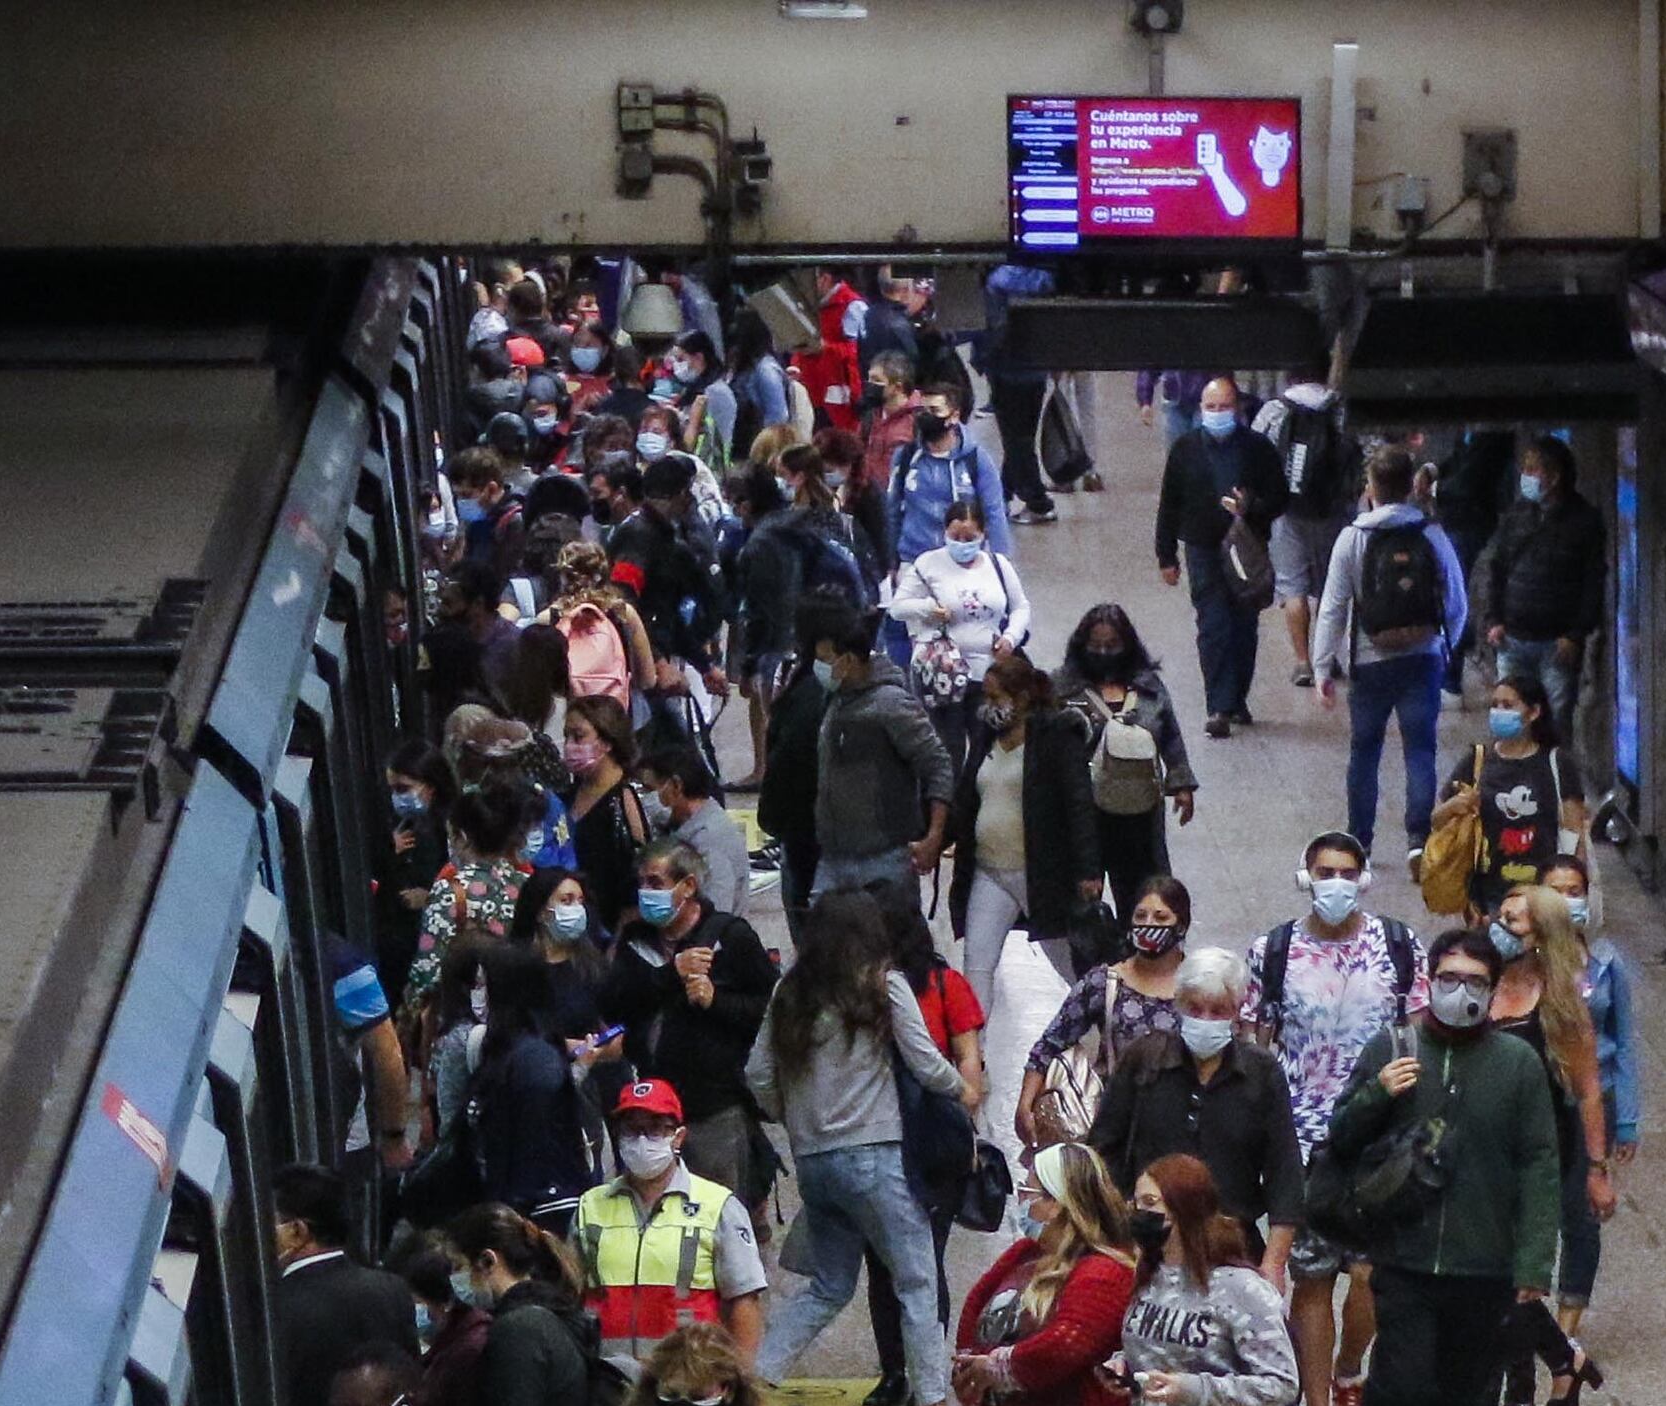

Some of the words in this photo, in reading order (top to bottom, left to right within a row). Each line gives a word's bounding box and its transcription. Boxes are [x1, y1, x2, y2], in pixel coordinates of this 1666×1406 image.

[1090, 109, 1159, 122] Cuéntanos
[1161, 110, 1199, 123] sobre
[1090, 124, 1105, 136] tu
[1107, 123, 1182, 137] experiencia
[1090, 138, 1107, 149] en
[1111, 207, 1154, 218] METRO
